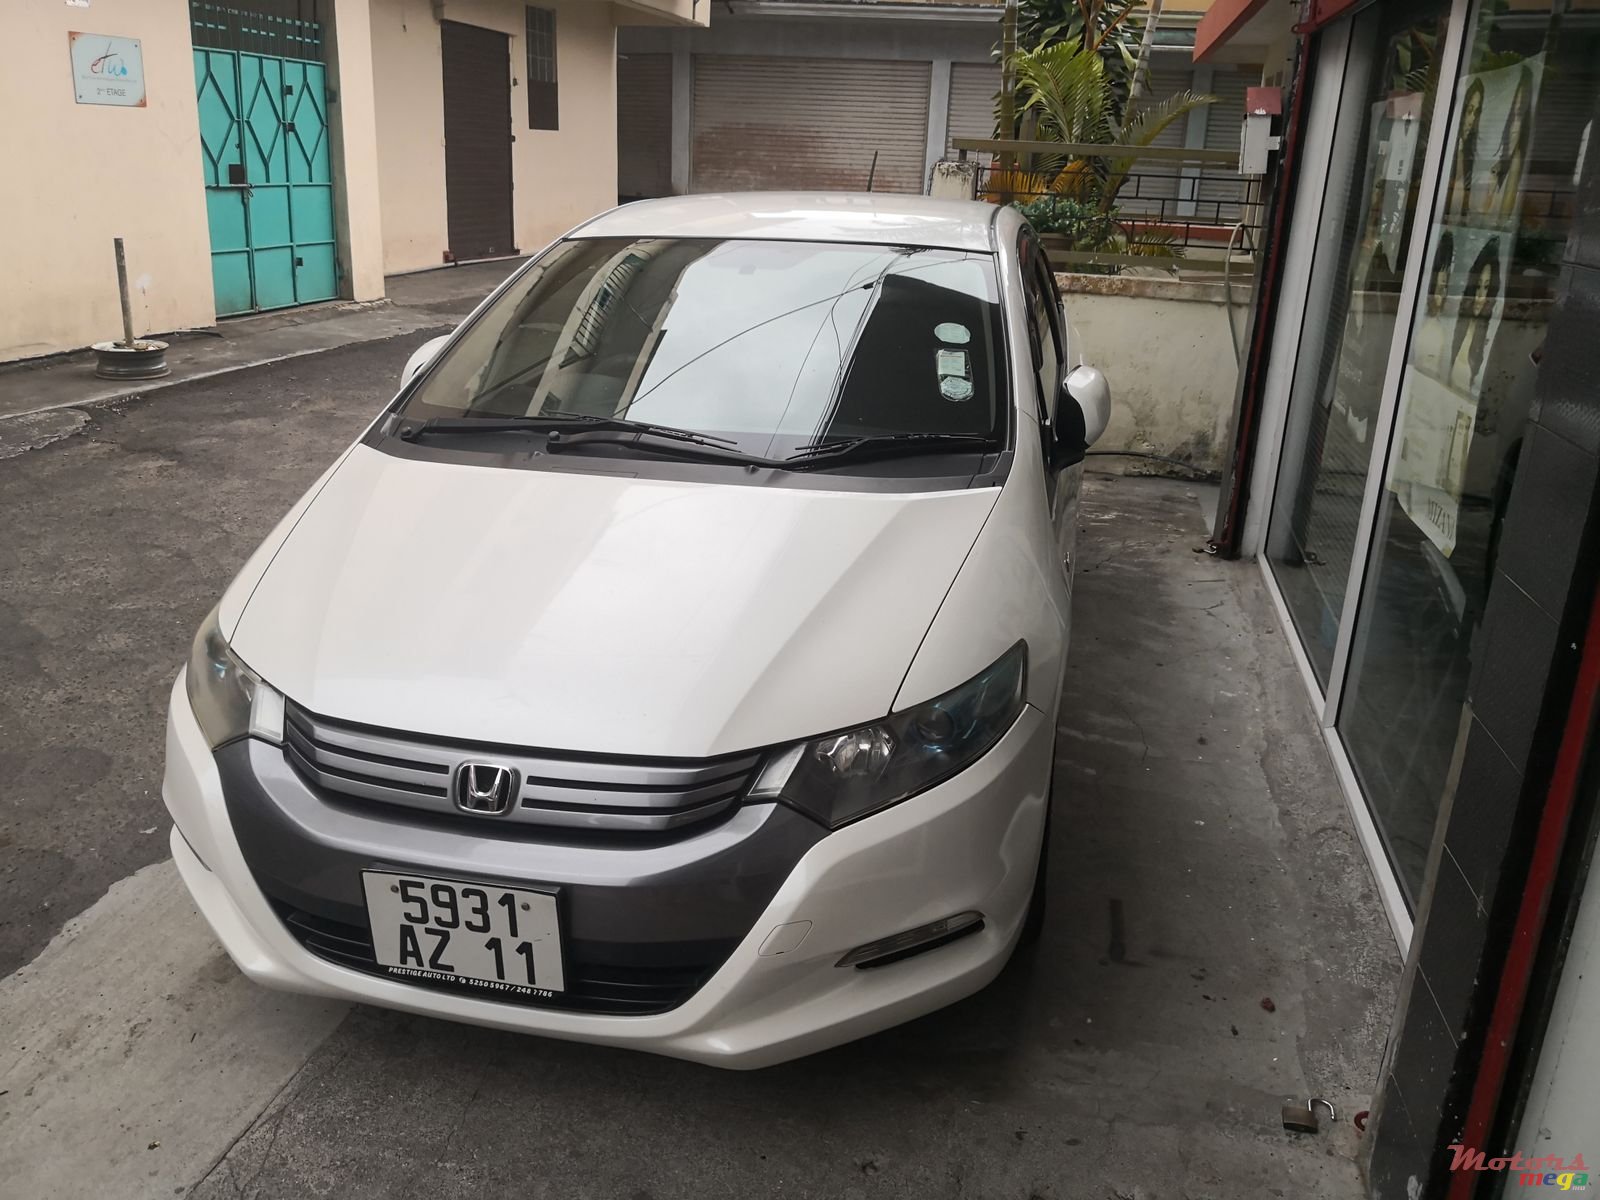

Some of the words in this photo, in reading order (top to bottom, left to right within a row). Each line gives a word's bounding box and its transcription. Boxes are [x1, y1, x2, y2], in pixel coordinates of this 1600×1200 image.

[398, 879, 519, 938] 5931
[388, 966, 422, 977] PRESTIGE
[422, 971, 442, 980] AUTO
[442, 974, 456, 982] LTD
[468, 978, 489, 987] 5250
[399, 923, 455, 973] AZ
[484, 937, 536, 985] 11
